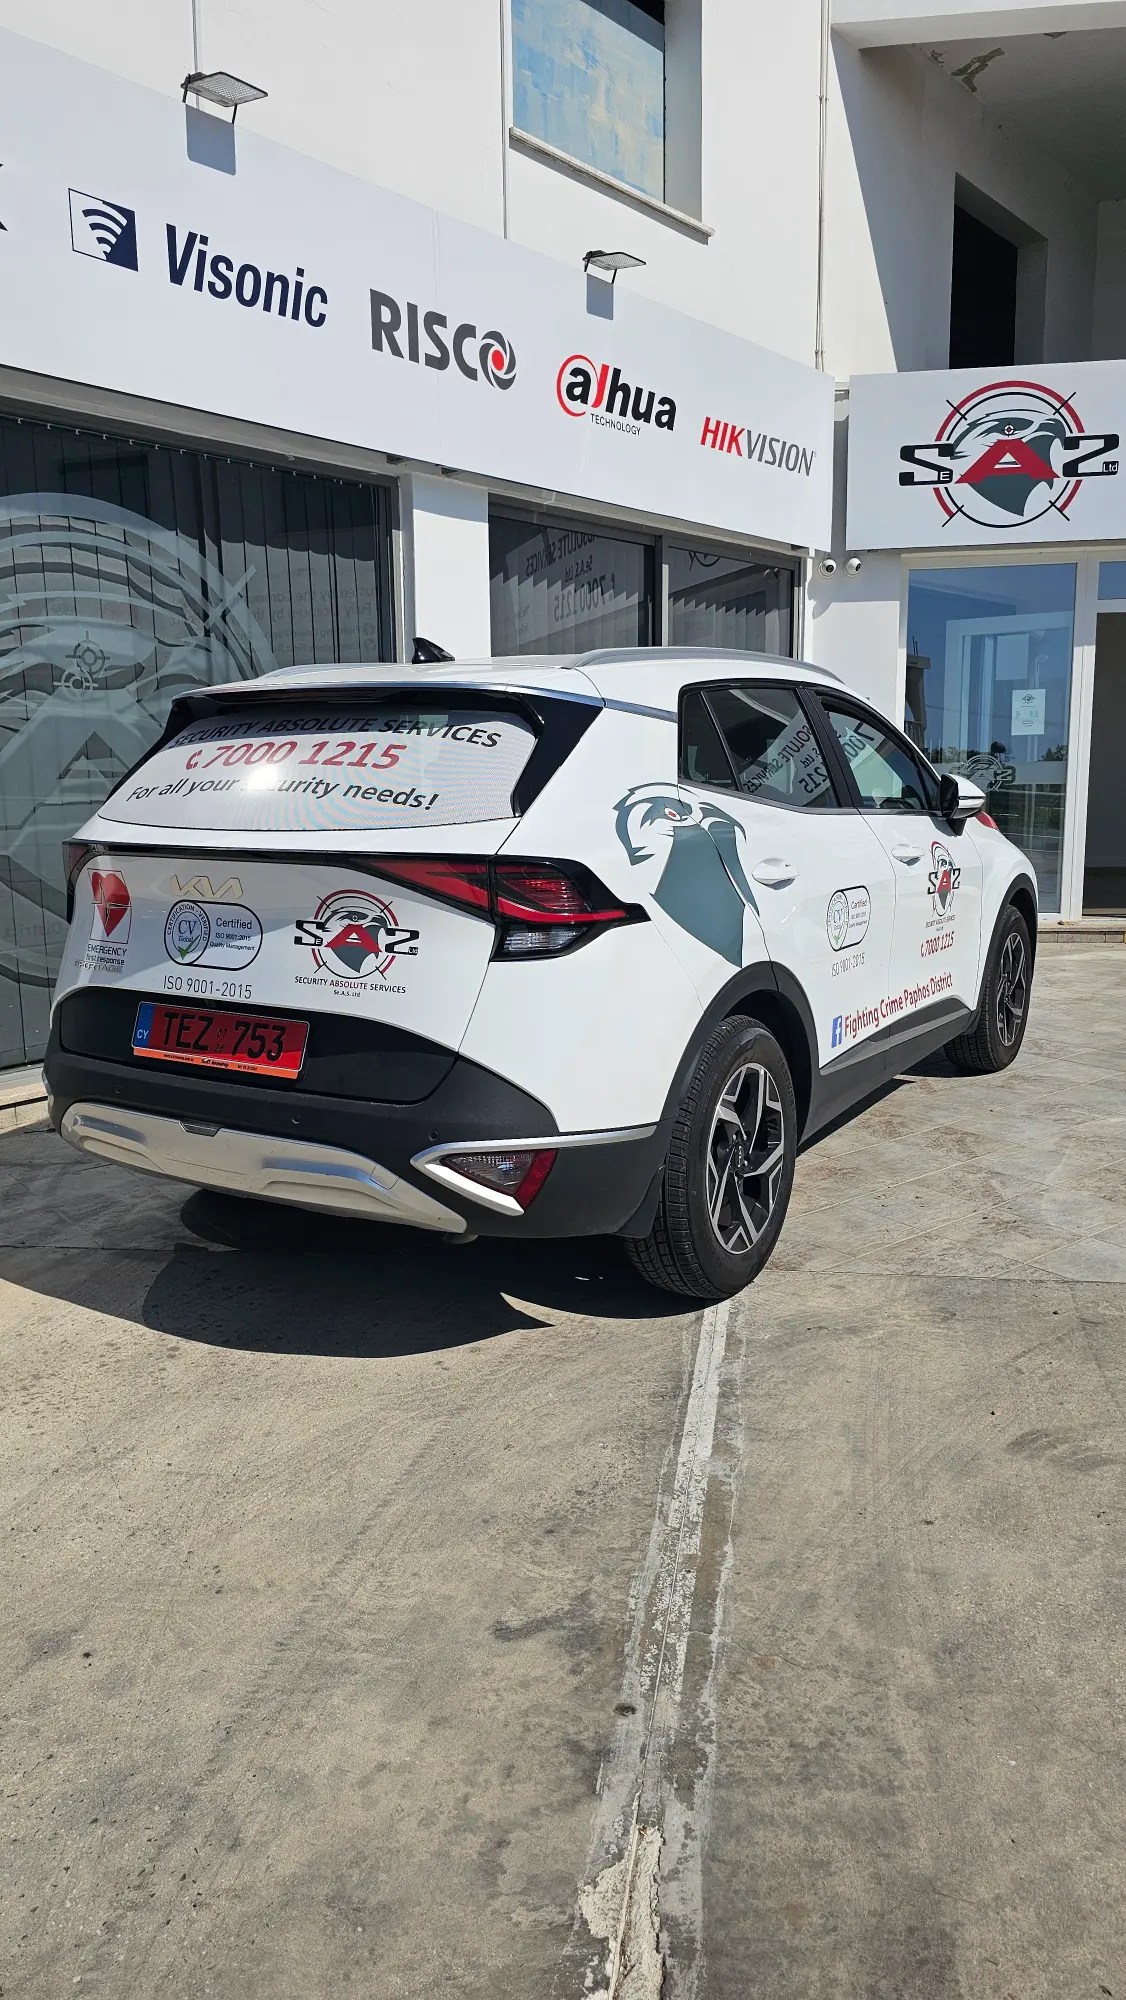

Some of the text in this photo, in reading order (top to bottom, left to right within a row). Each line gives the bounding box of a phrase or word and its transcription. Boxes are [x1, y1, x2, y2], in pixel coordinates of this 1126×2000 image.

[165, 222, 328, 328] Visonic
[369, 287, 517, 391] RISCO
[590, 412, 642, 437] TECHNOLOGY
[699, 416, 815, 477] HIKVISION
[168, 717, 502, 749] SECURITY ABSOLUTE SERVICES
[201, 740, 408, 770] 7000 1215
[126, 786, 160, 802] For
[158, 777, 190, 797] all
[182, 777, 241, 798] your
[342, 783, 439, 811] needs!
[178, 919, 197, 936] CV
[215, 917, 253, 930] Certified
[215, 932, 225, 940] ISO
[87, 943, 128, 957] EMERGENCY
[831, 962, 841, 978] ISO
[164, 975, 253, 1000] ISO 9001-2015
[294, 975, 407, 995] SECURITY ABSOLUTE SERVICES
[844, 1006, 881, 1040] Fighting
[879, 995, 904, 1019] Crime
[903, 983, 931, 1009] Paphos
[930, 971, 954, 996] District
[136, 1028, 150, 1040] CY
[162, 1011, 214, 1052] TEZ
[231, 1020, 287, 1062] 753
